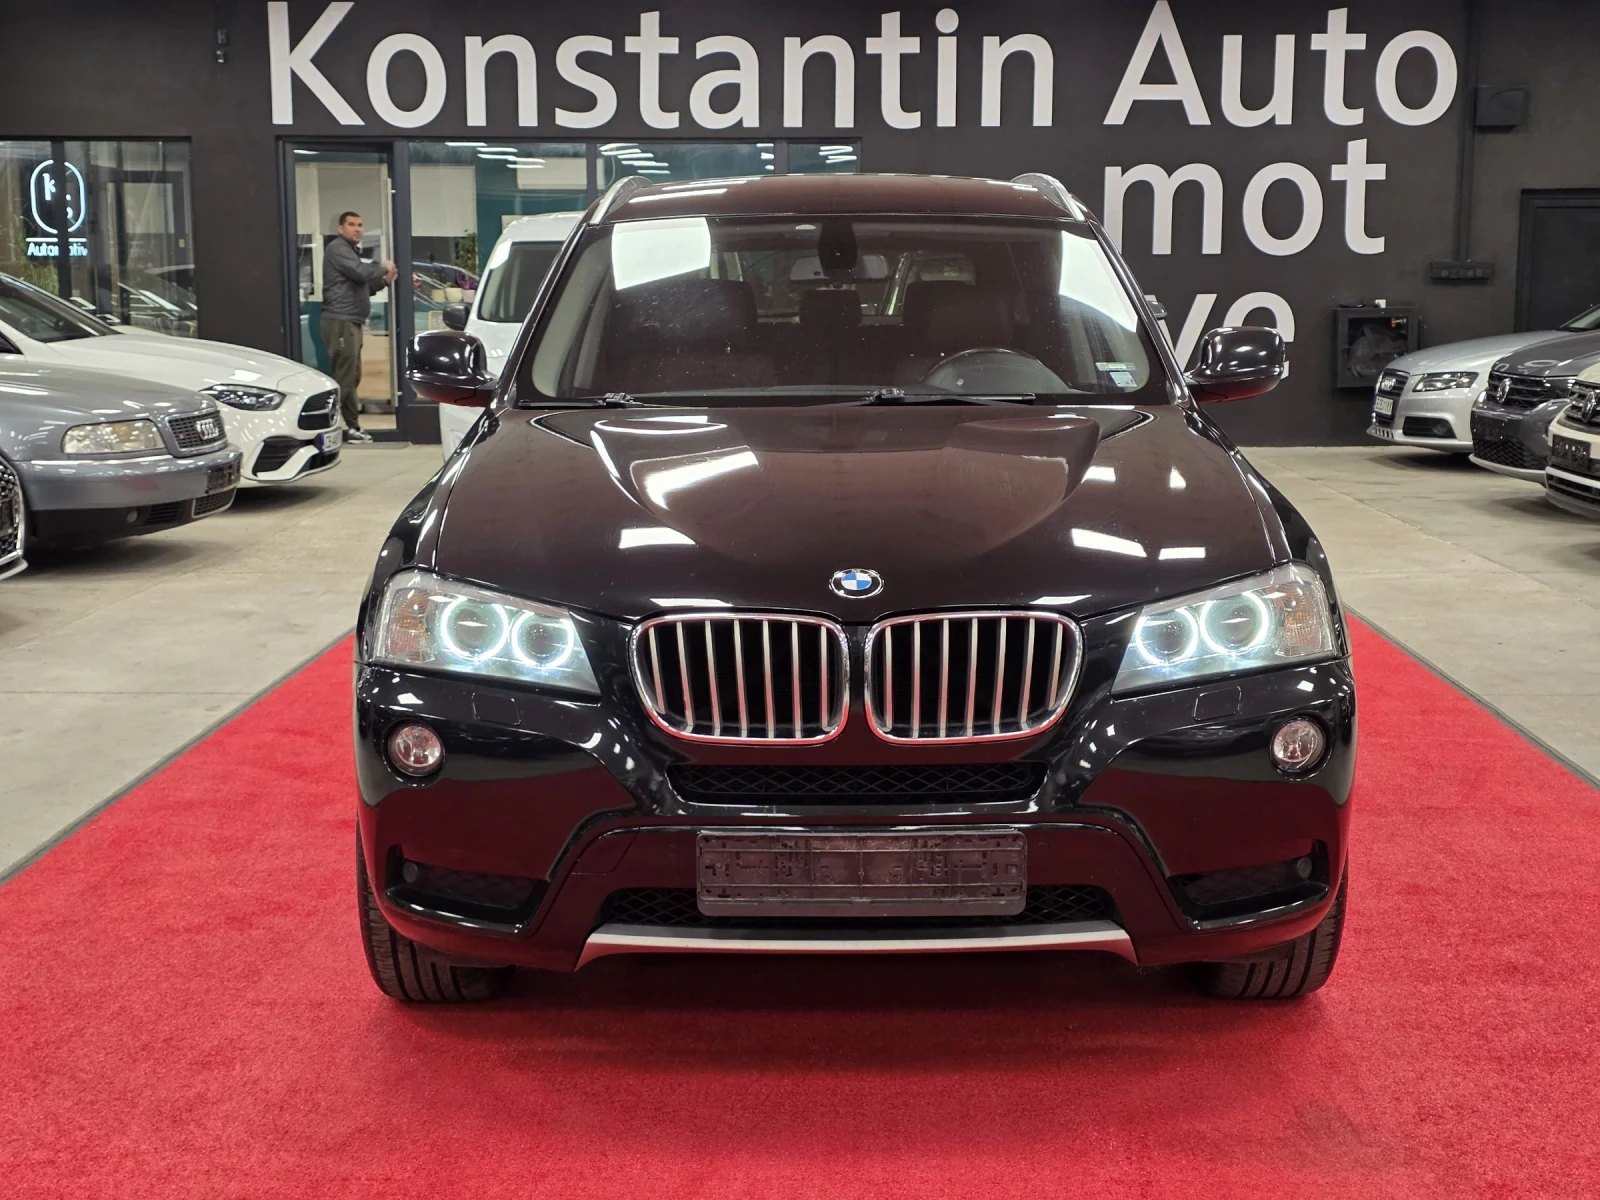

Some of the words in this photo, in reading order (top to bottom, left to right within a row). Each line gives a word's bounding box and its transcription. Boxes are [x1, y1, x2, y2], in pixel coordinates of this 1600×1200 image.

[267, 1, 1054, 130] Konstantin
[1102, 0, 1458, 128] Auto
[1102, 138, 1387, 256] mot
